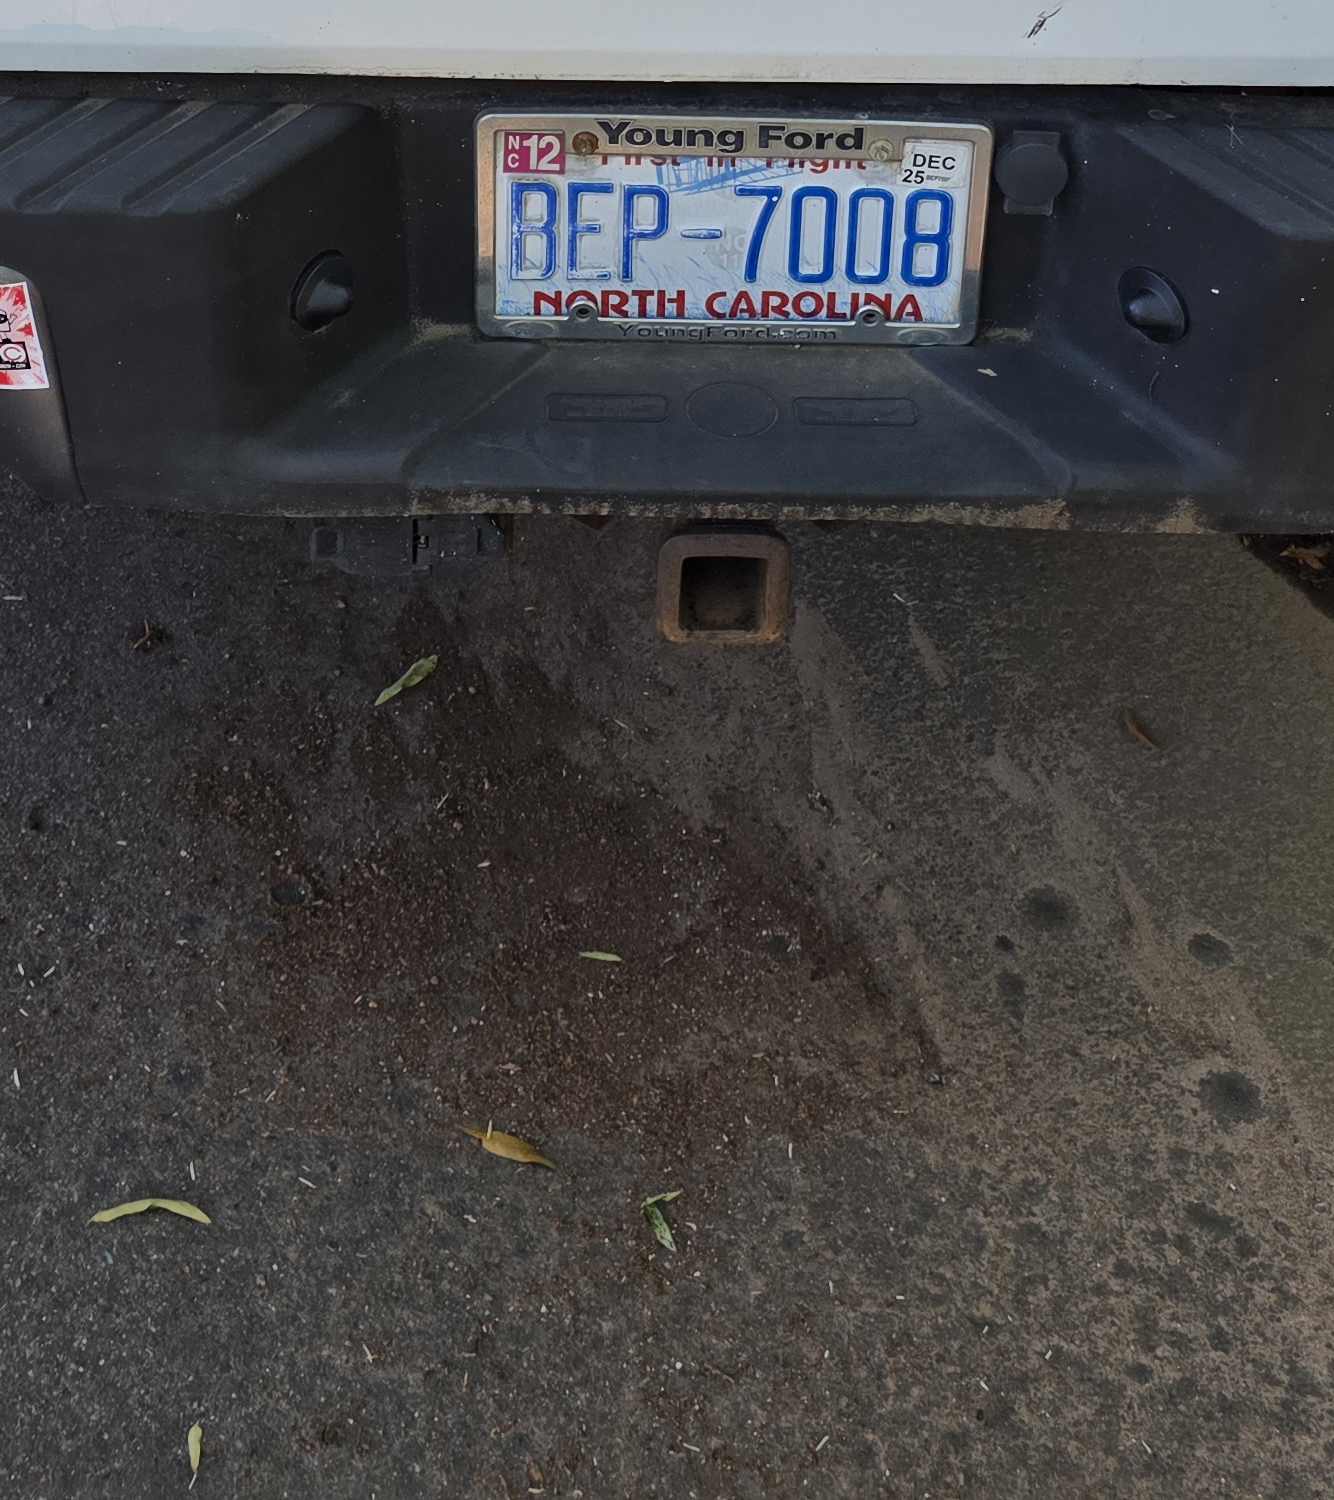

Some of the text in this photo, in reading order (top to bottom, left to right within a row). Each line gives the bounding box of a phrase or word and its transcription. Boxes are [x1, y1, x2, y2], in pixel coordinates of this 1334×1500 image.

[523, 134, 561, 171] 12
[596, 120, 866, 153] Young Ford
[902, 169, 925, 184] 25
[912, 153, 957, 170] DEC
[510, 181, 954, 288] BEP-7008
[533, 289, 924, 322] NORTH CAROLINA
[616, 322, 838, 341] YoungFord.com
